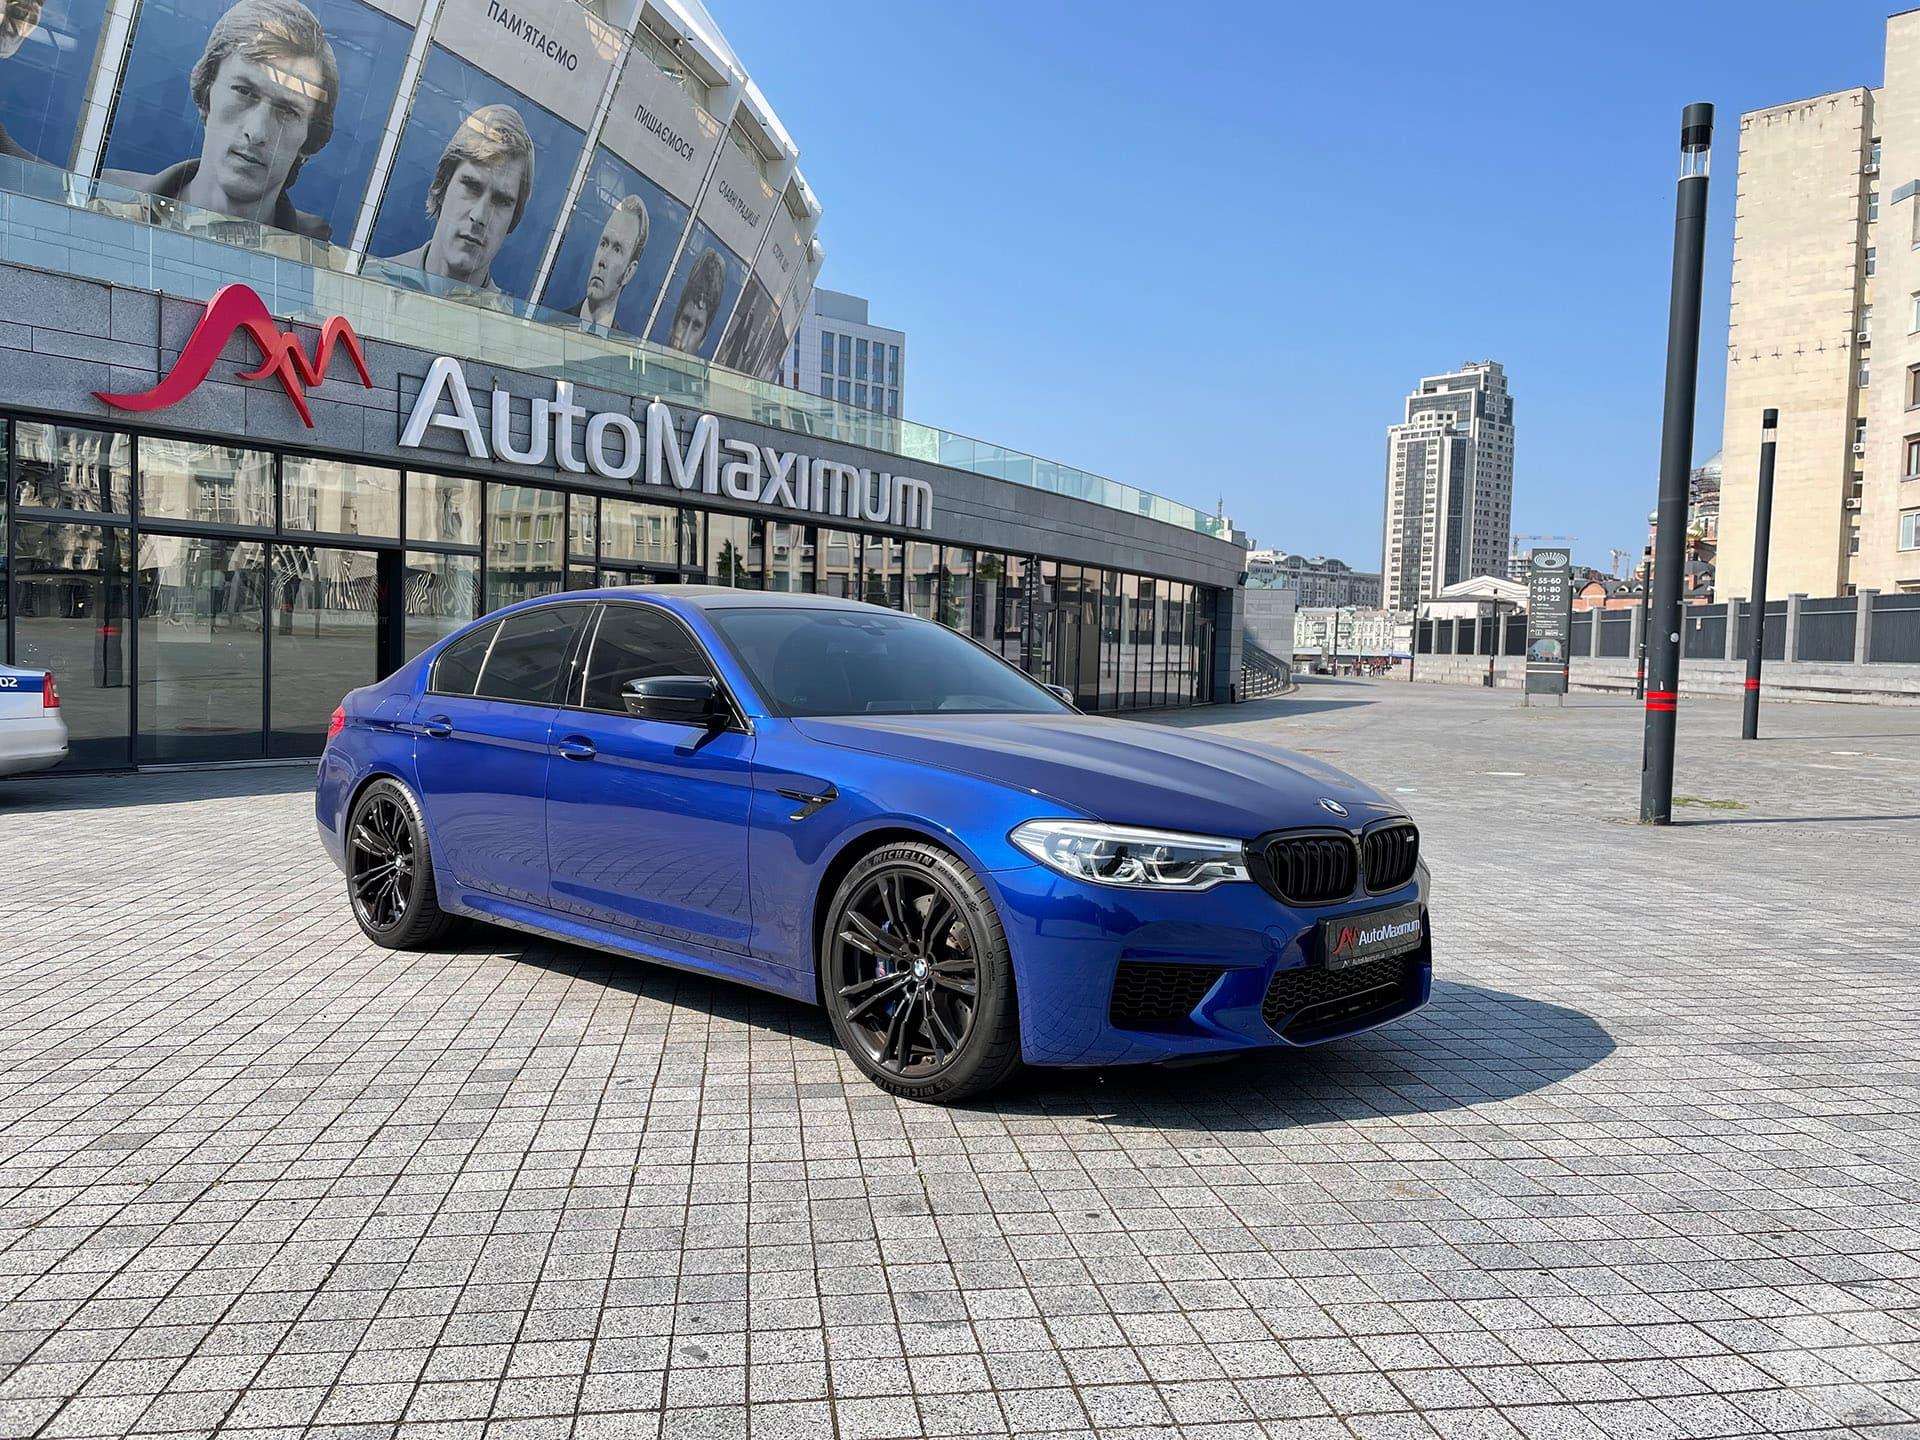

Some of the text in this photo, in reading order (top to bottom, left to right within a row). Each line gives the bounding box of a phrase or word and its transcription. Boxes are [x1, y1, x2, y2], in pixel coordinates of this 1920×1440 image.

[488, 0, 578, 71] ПАМ'ЯТАЄМО
[634, 104, 695, 162] ПИШАЄМОСЯ
[399, 356, 933, 530] AutoMaximum
[873, 849, 933, 866] MICHELIN
[1358, 919, 1420, 946] AutoMaximum
[875, 1075, 935, 1097] MICHELIN
